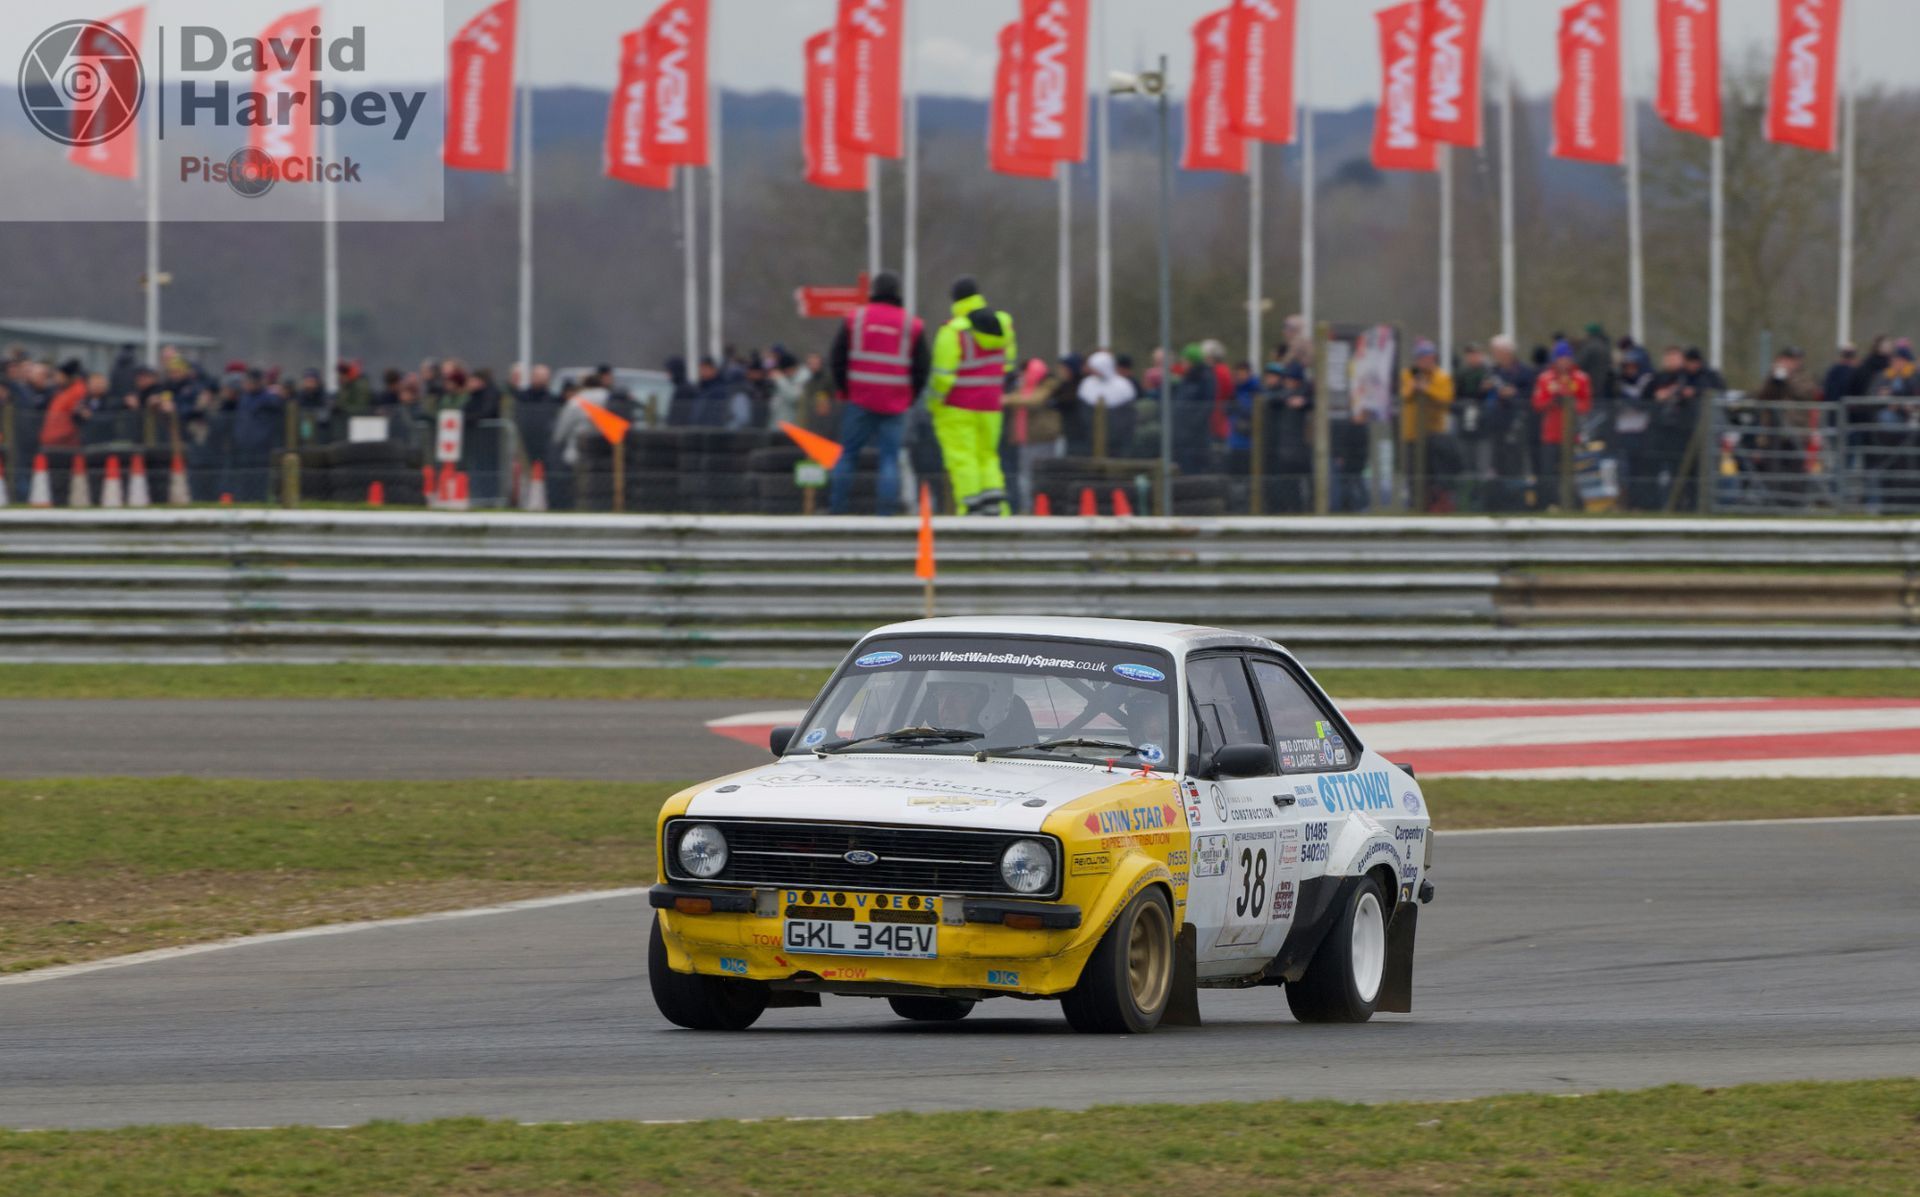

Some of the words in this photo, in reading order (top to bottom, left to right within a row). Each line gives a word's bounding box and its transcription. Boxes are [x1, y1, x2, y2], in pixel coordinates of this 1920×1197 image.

[908, 651, 1107, 673] www.WestWalesRallySpares.co.uk
[1297, 753, 1317, 768] LARGE
[1317, 772, 1394, 813] OTTOWAY
[1099, 811, 1131, 833] LYNN
[1133, 806, 1164, 831] STAR
[1230, 808, 1274, 820] CONSTRUCTION
[1305, 822, 1328, 841] 01485
[1395, 825, 1424, 843] Carpentry
[1167, 850, 1188, 866] 01553
[1301, 843, 1330, 862] 540260
[1405, 844, 1412, 860] &
[1236, 847, 1267, 918] 38
[752, 934, 782, 946] TOW
[788, 921, 845, 949] GKL
[854, 924, 933, 952] 346V
[837, 968, 868, 979] TOW
